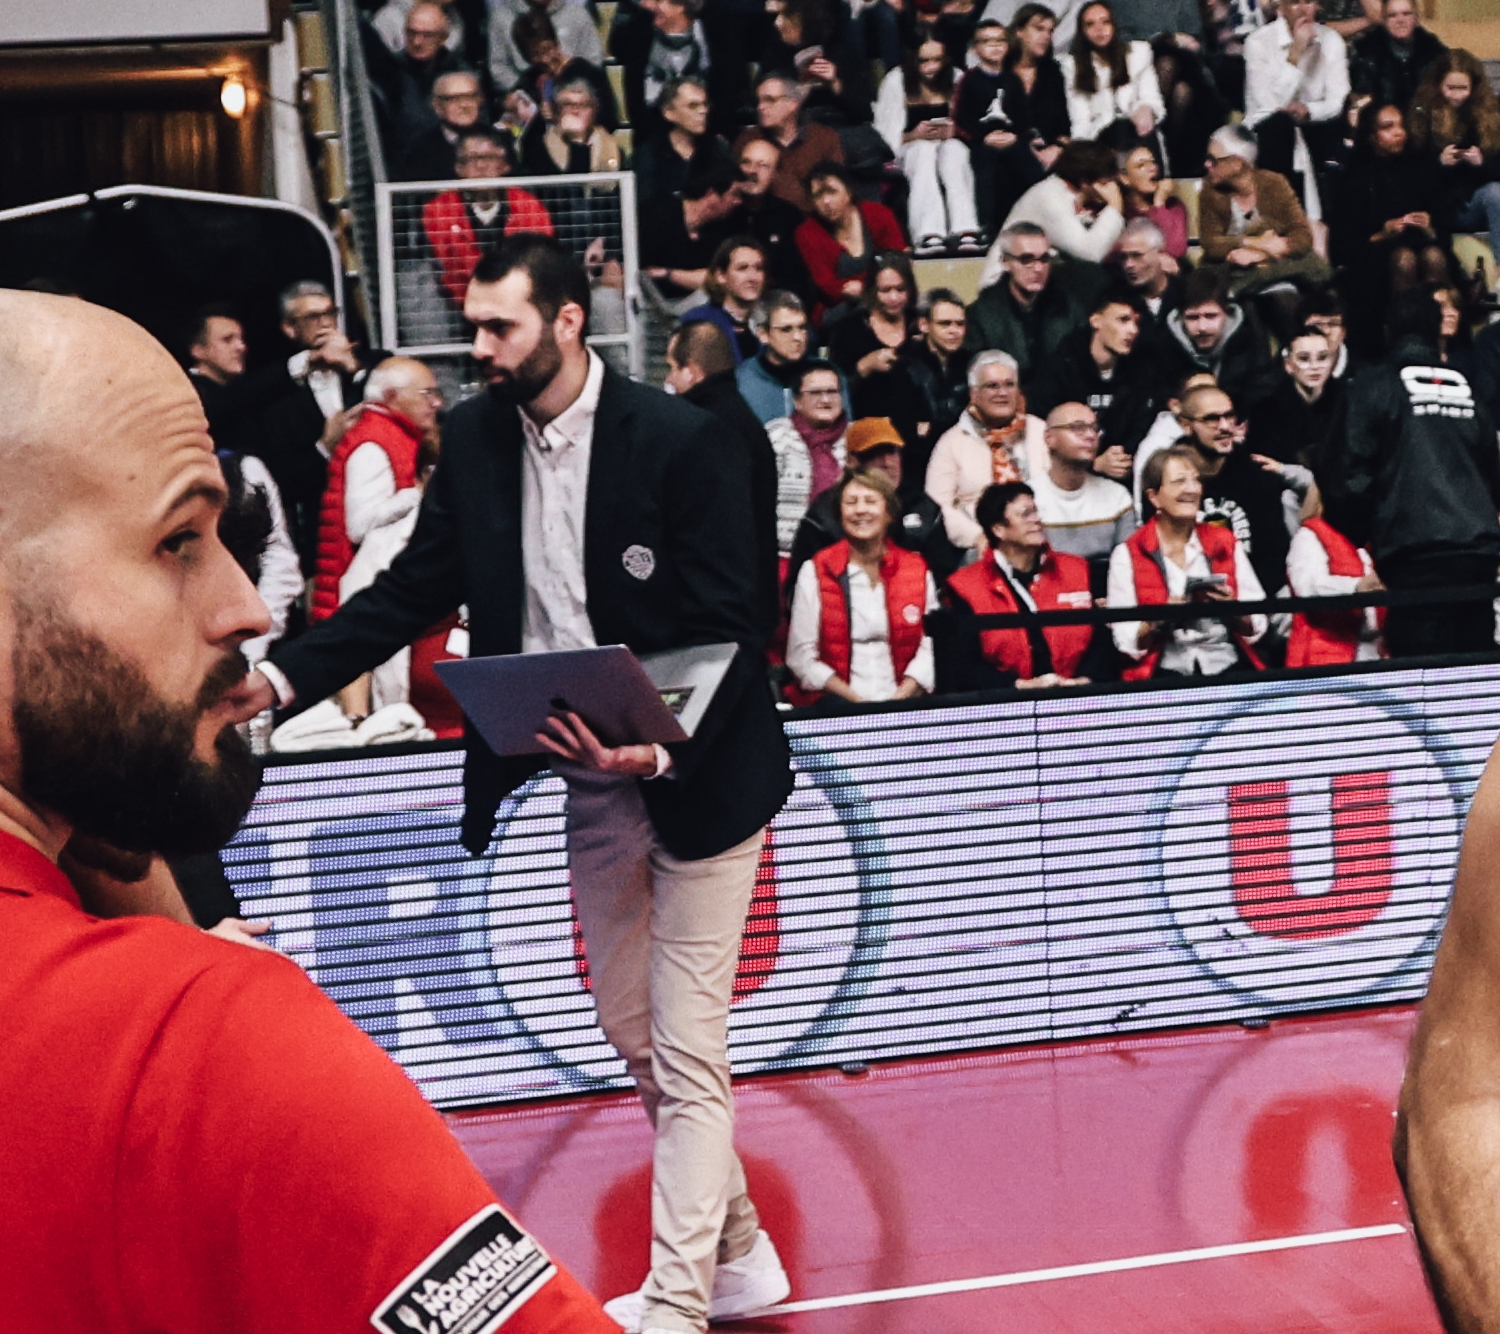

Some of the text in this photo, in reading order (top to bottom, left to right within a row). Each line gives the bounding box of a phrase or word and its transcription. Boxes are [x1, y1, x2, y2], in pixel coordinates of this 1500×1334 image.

[1227, 767, 1395, 940] U
[411, 1278, 442, 1305] LA
[422, 1232, 513, 1318] NOUVELLE
